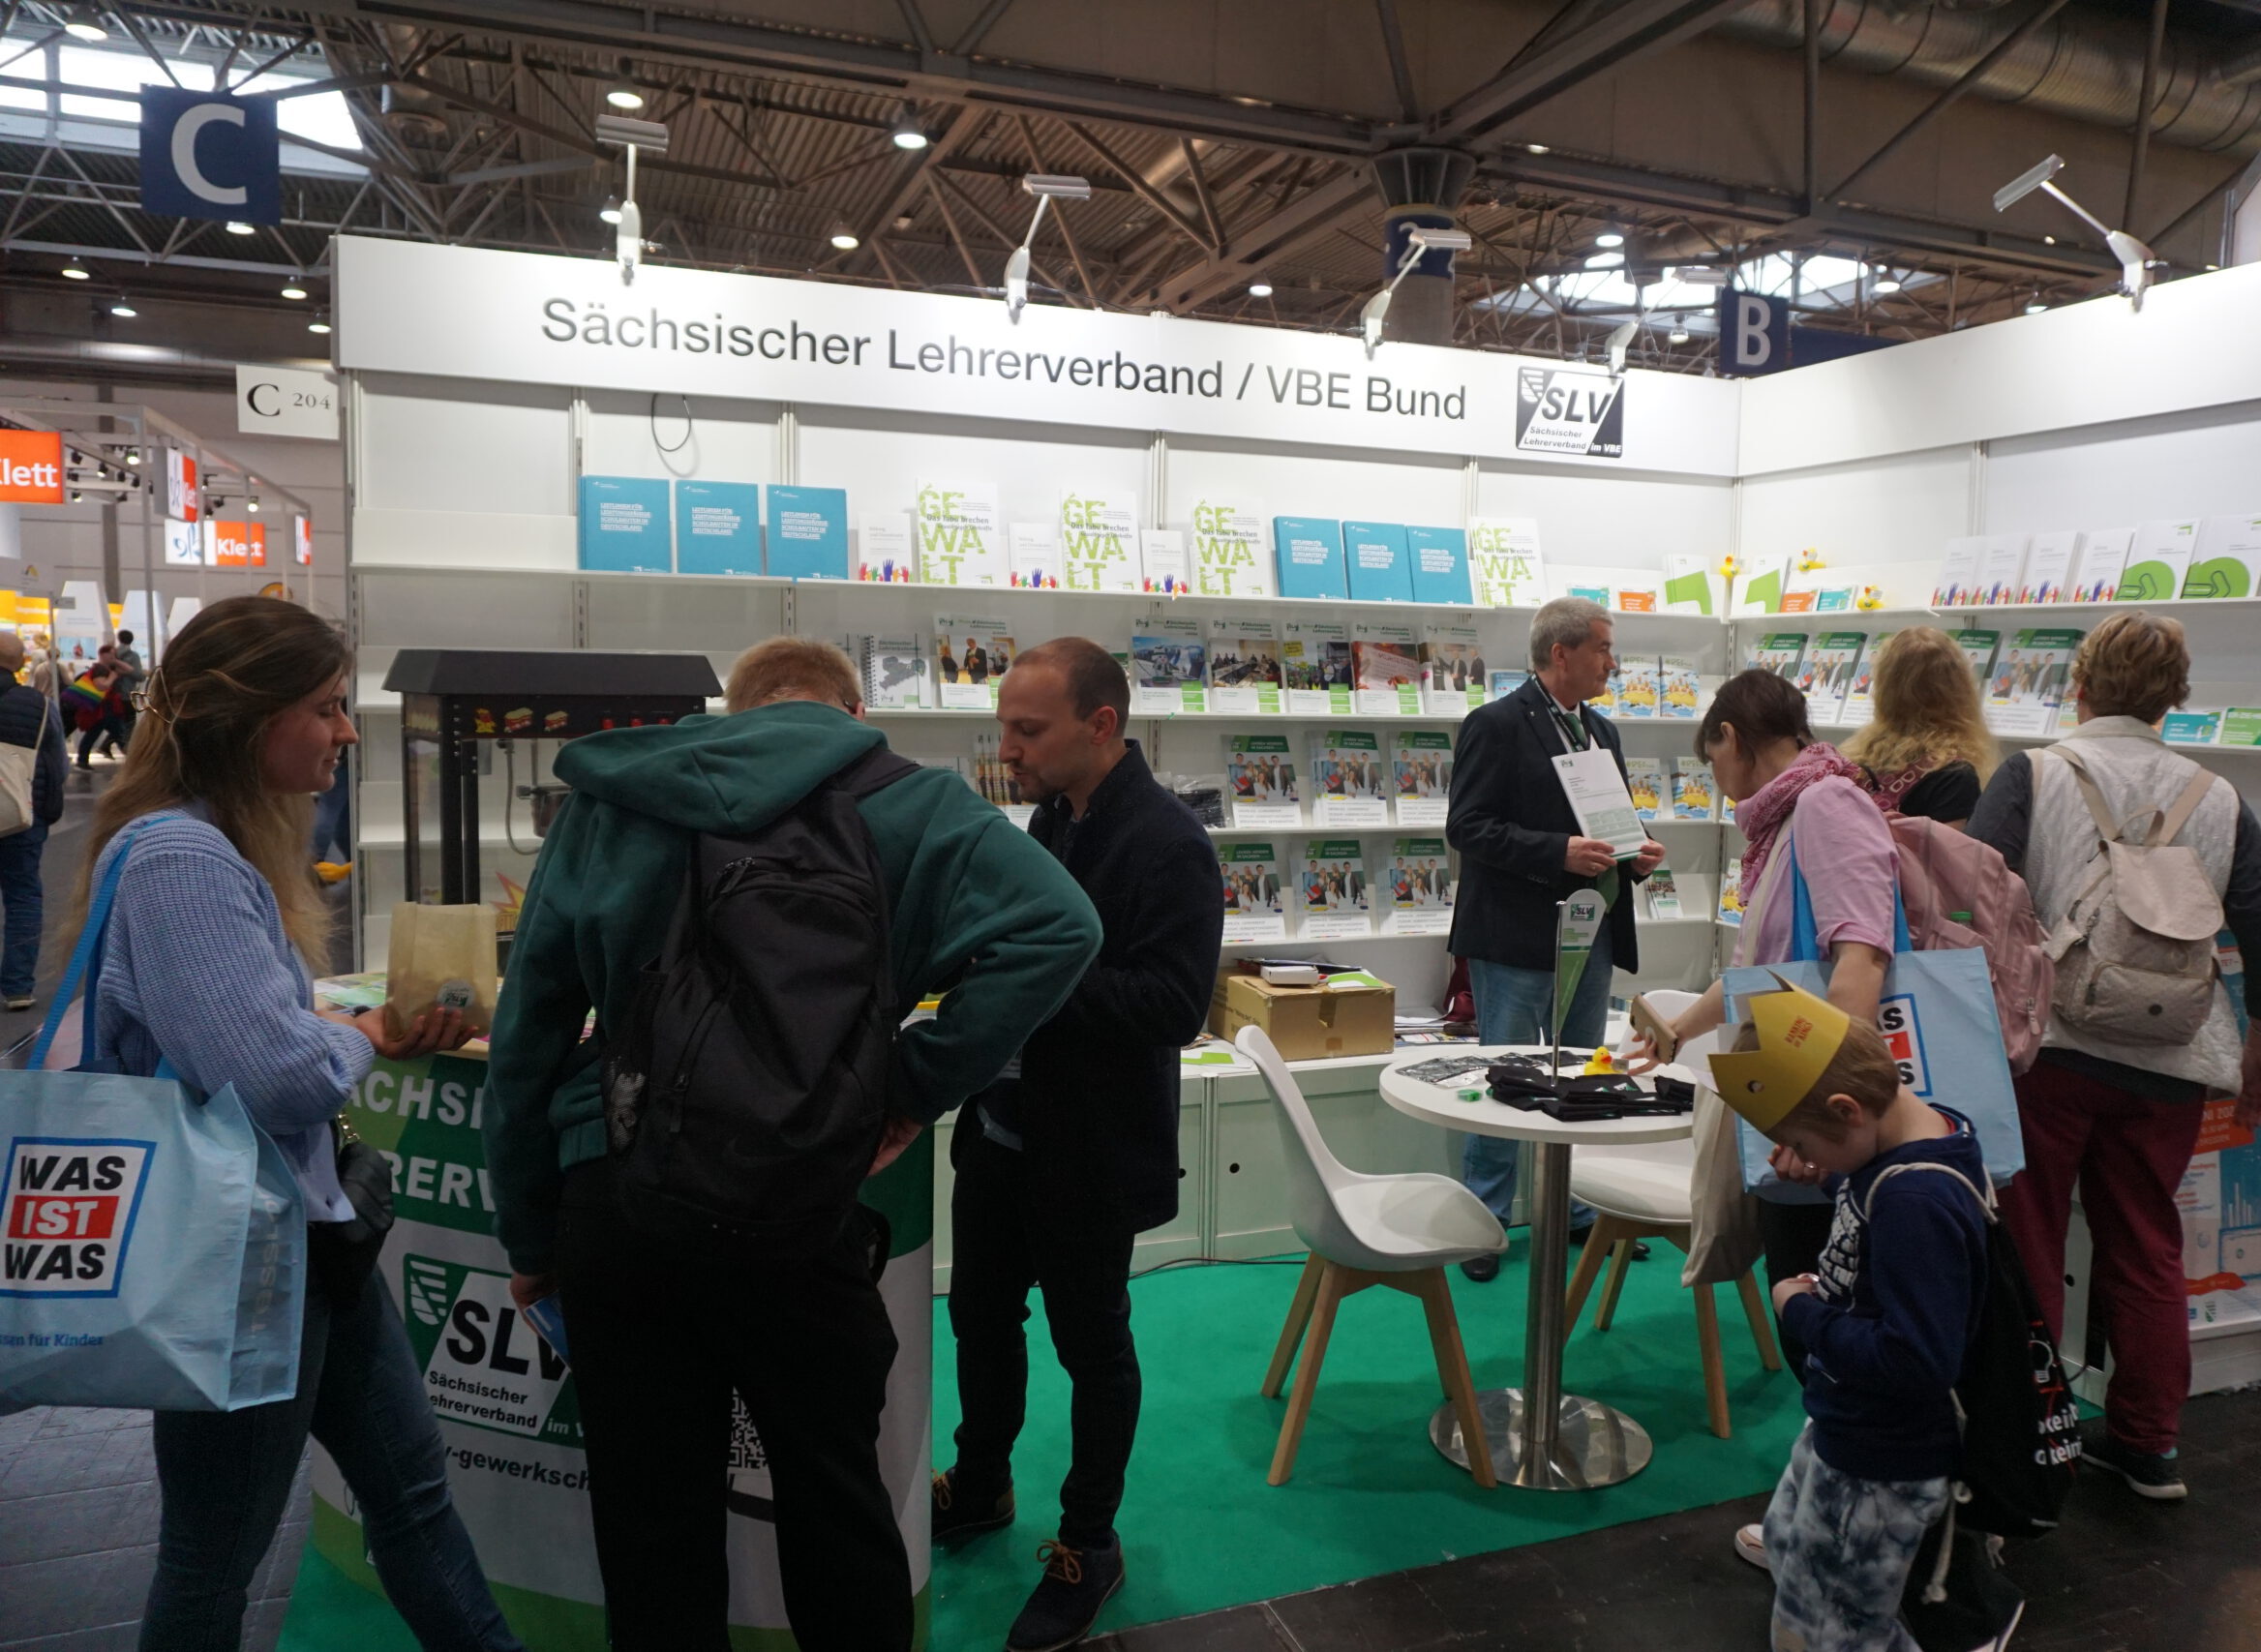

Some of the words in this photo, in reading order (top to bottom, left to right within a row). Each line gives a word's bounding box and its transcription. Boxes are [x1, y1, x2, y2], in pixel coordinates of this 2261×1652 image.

[171, 103, 249, 205] C
[1737, 295, 1771, 366] B
[541, 297, 871, 366] Sächsischer
[889, 328, 1222, 398] Lehrerverband
[1266, 365, 1351, 409] VBE
[1367, 375, 1465, 420] Bund
[247, 383, 281, 417] C
[292, 392, 331, 409] 204
[1541, 386, 1613, 425] SLV
[1523, 436, 1586, 450] Lehrerverband
[1590, 442, 1602, 453] im
[1604, 443, 1622, 453] VBE
[1529, 426, 1583, 438] Sächsischer
[0, 461, 58, 488] lett
[19, 1156, 126, 1191] WAS
[22, 1200, 99, 1236] IST
[5, 1244, 106, 1280] WAS
[53, 1334, 104, 1347] Kinder
[429, 1370, 528, 1405] Sächsischer
[430, 1395, 538, 1428] ehrerverband
[547, 1418, 569, 1435] im
[445, 1446, 590, 1491] -gewerksch
